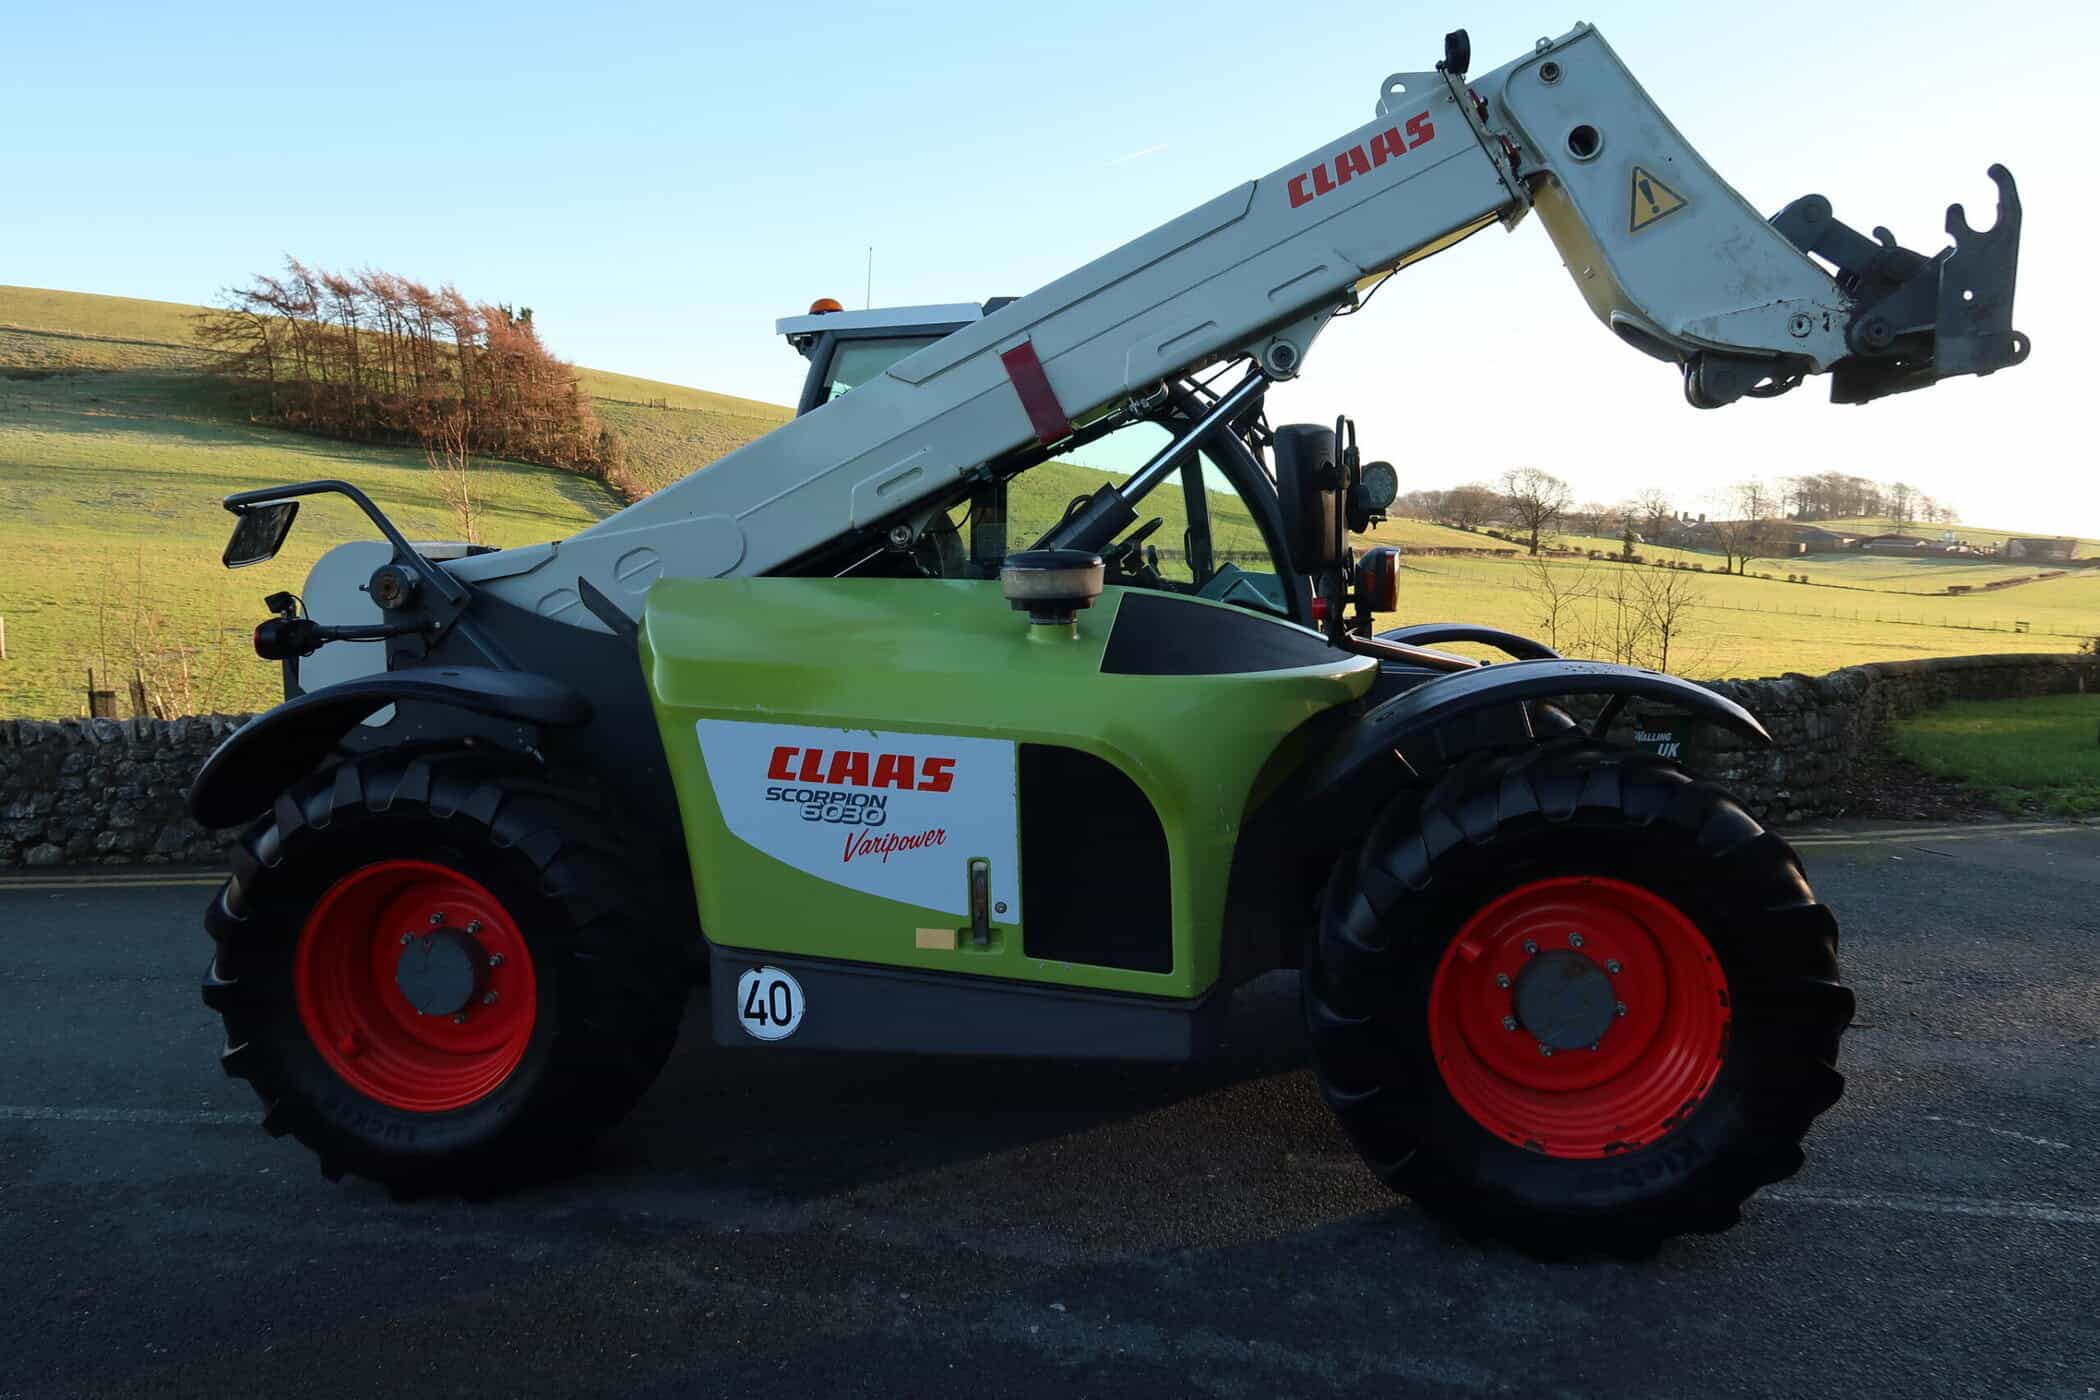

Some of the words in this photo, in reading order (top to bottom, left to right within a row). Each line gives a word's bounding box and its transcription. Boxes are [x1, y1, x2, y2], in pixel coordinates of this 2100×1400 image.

[1287, 111, 1435, 208] CLAAS
[1657, 743, 1680, 757] UK
[768, 746, 956, 792] CLAAS
[766, 787, 887, 809] SCORPION
[800, 801, 887, 826] 6030
[843, 828, 947, 863] Varipower
[743, 979, 793, 1027] 40
